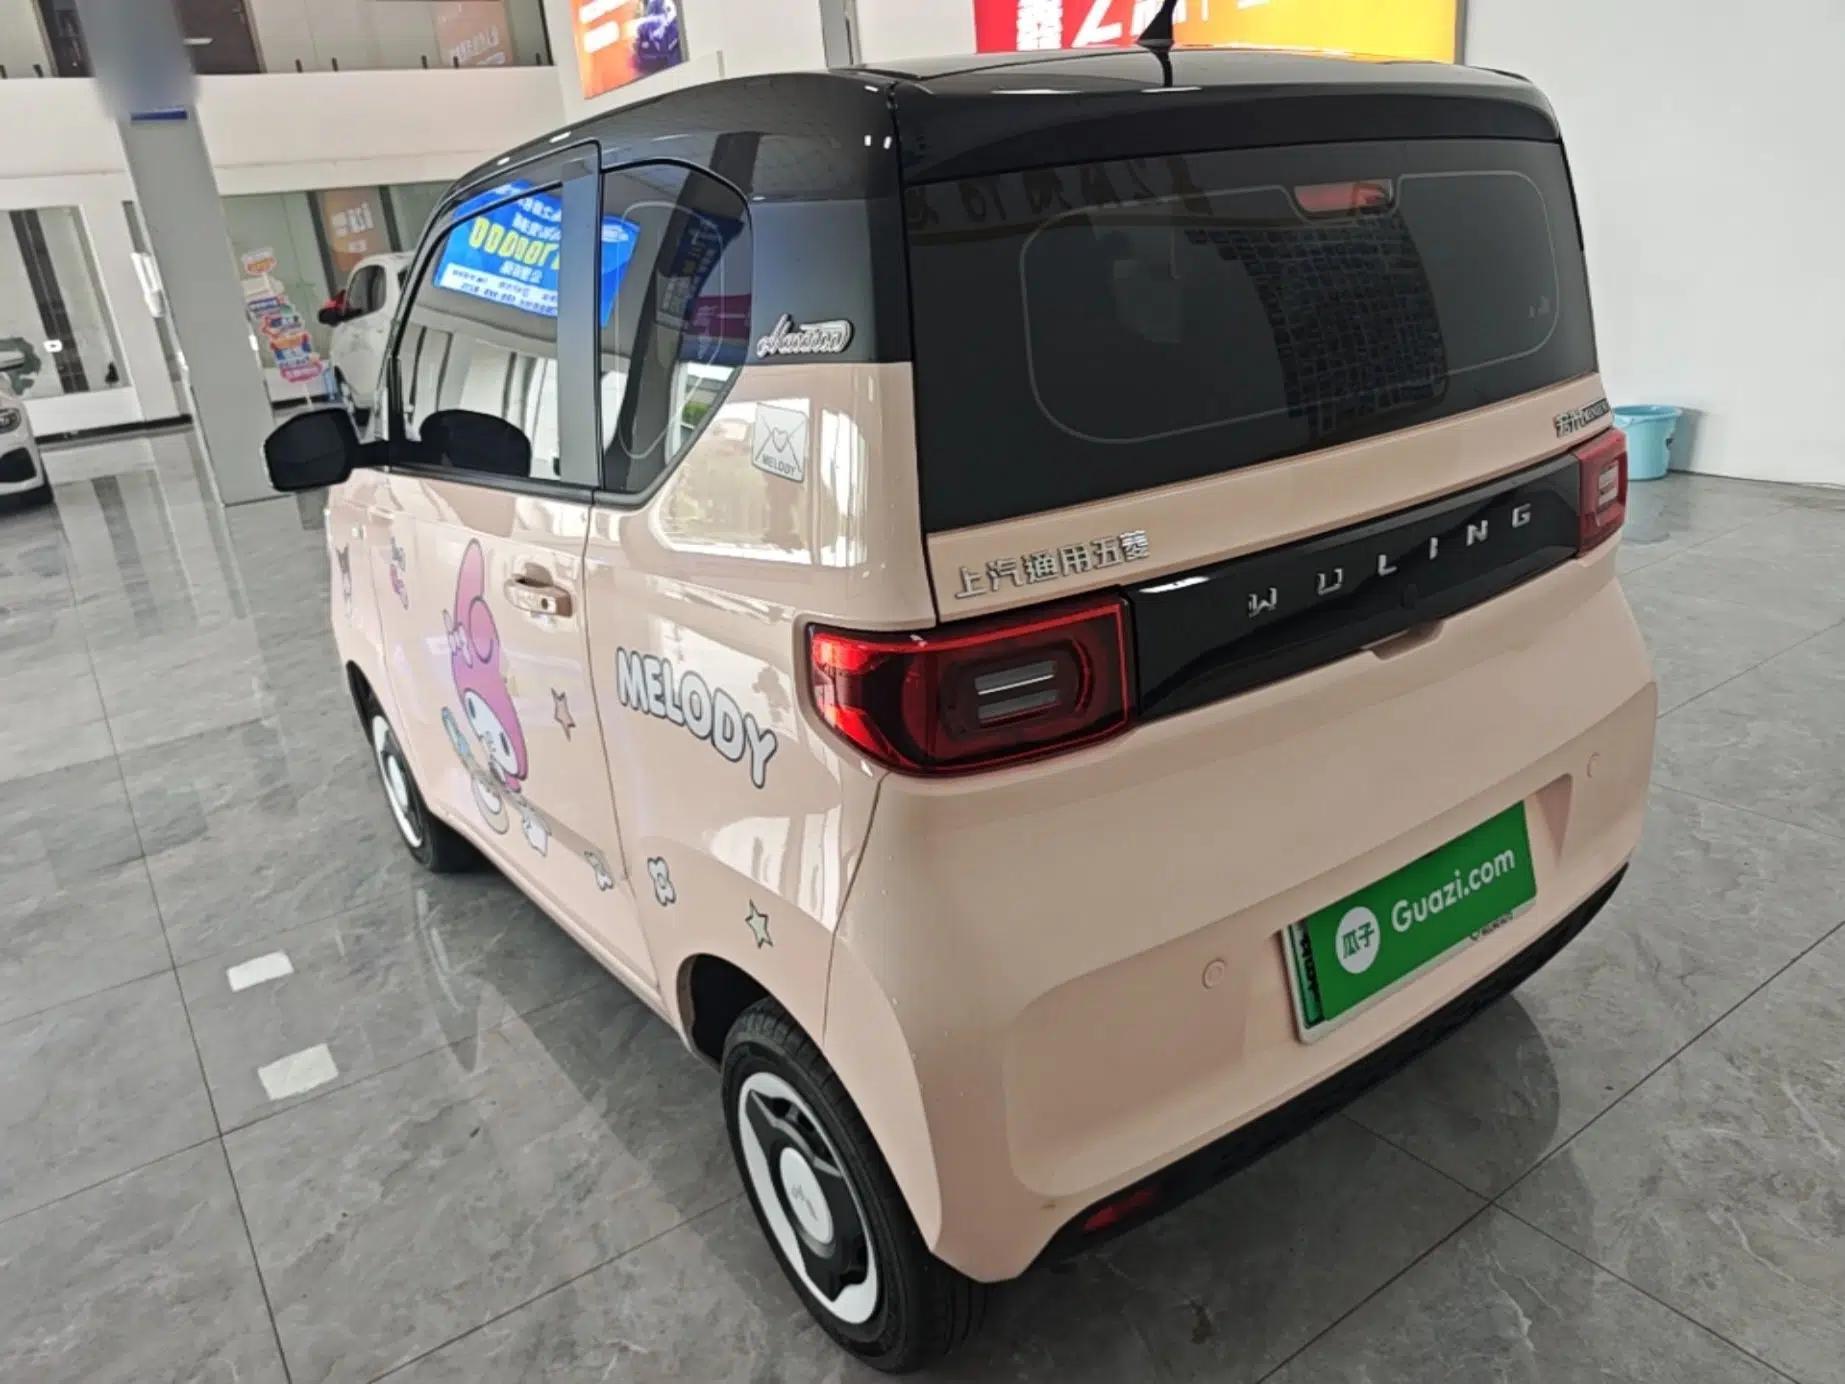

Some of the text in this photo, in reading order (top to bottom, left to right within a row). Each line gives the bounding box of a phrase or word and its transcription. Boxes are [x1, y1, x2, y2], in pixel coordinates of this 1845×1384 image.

[762, 453, 796, 476] MELODY
[955, 530, 1150, 598] 上汽通用五菱
[1248, 503, 1532, 618] WULING
[616, 646, 778, 789] MELODY
